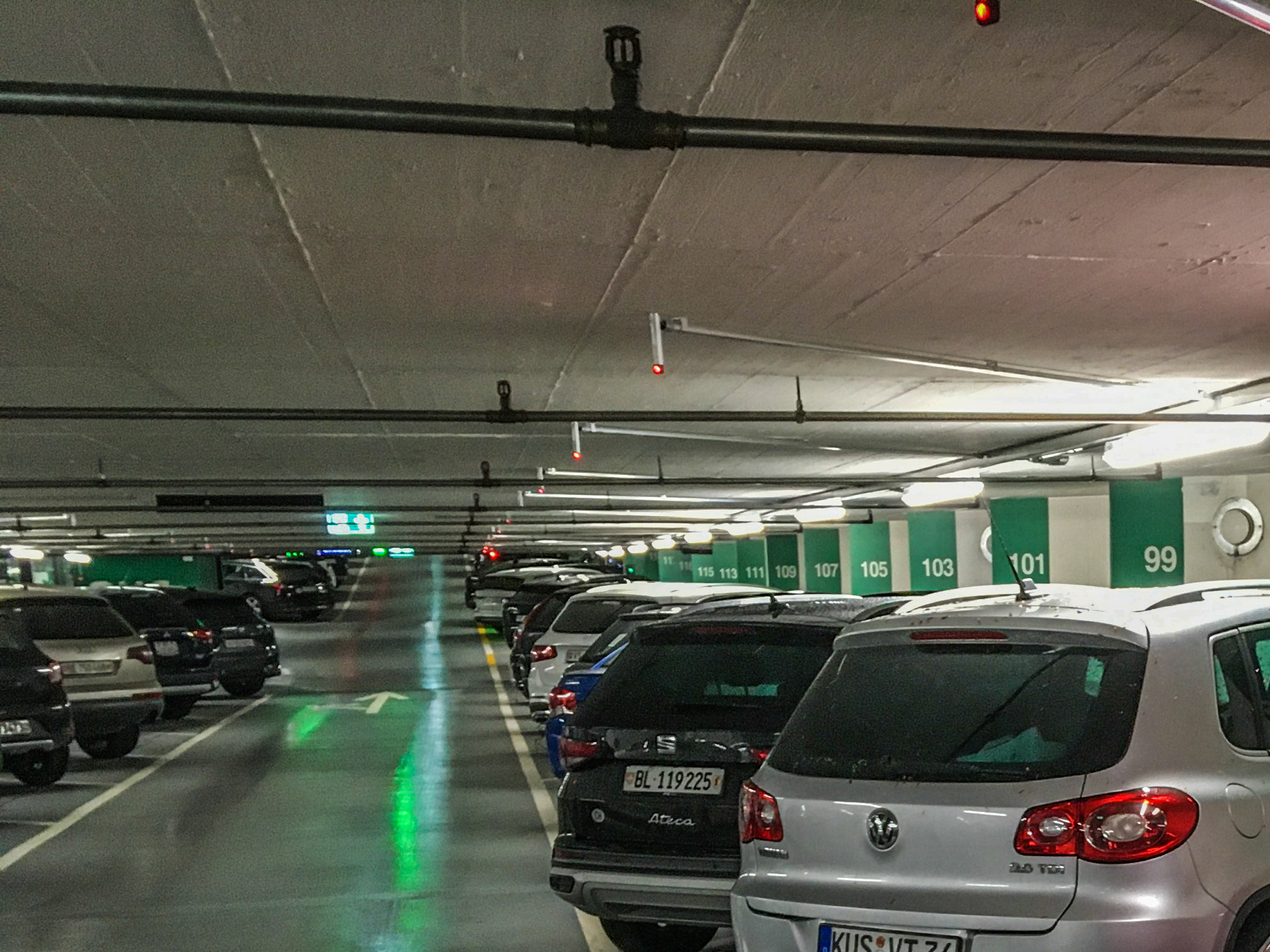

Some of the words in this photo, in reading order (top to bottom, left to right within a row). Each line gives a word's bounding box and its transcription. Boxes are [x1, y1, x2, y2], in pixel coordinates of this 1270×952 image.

[1010, 553, 1045, 575] 101
[1144, 546, 1177, 573] 99
[698, 566, 715, 577] 115
[719, 568, 738, 579] 113
[746, 566, 764, 579] 111
[775, 565, 797, 579] 109
[814, 563, 839, 578] 107
[860, 561, 889, 578] 105
[922, 558, 954, 577] 103
[634, 769, 651, 789] BL
[657, 770, 713, 791] 119225
[648, 812, 697, 827] Ateca
